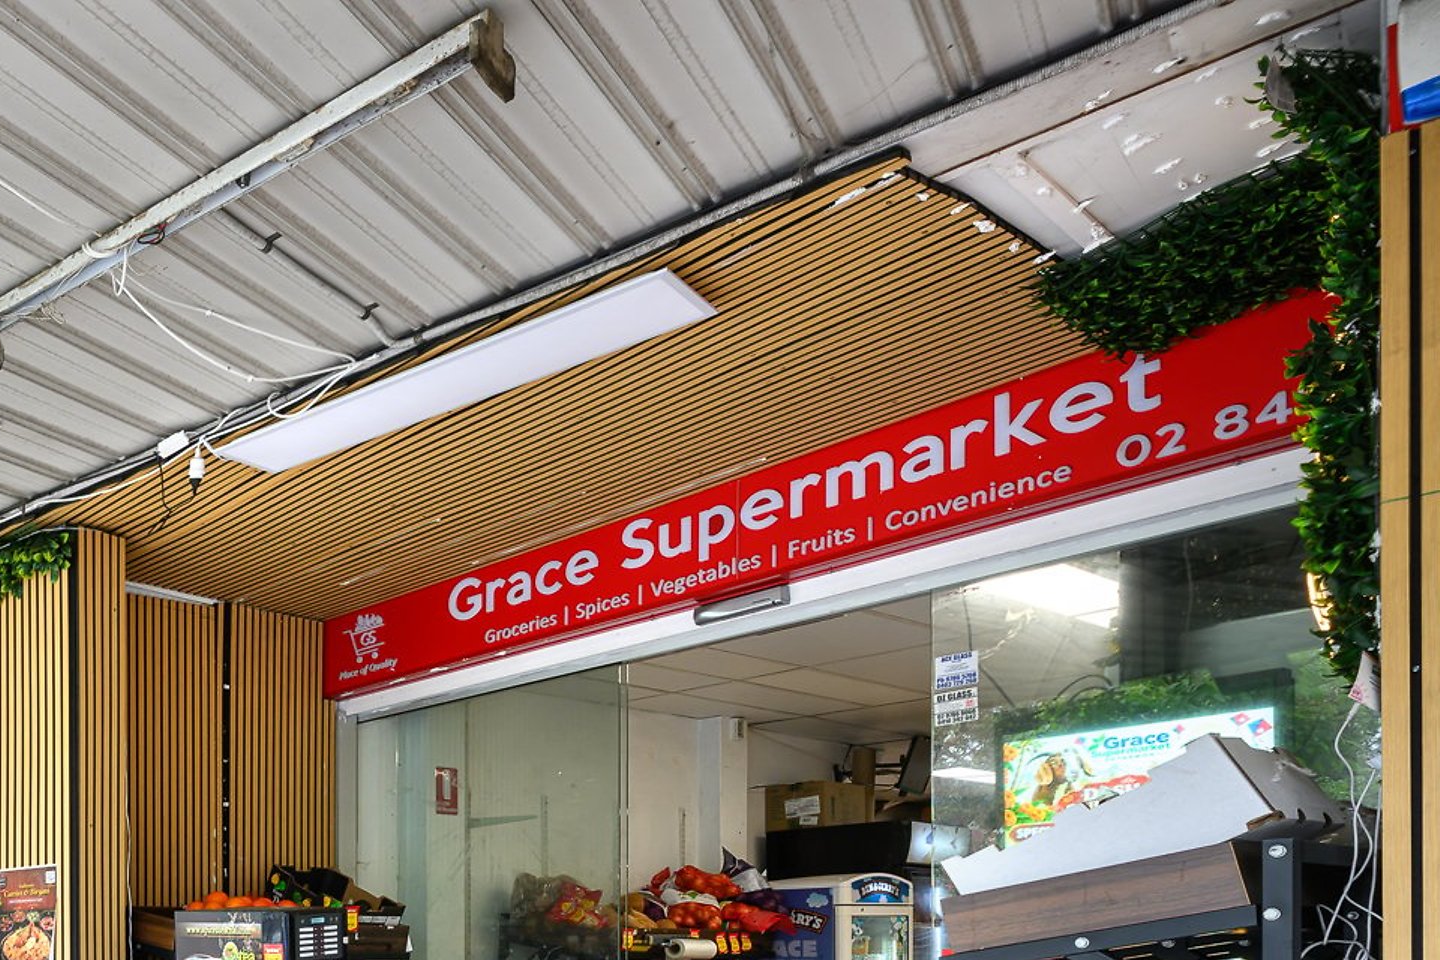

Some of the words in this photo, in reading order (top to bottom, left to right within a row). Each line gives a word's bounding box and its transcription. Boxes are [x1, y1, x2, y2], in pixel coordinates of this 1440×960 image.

[1115, 422, 1187, 468] 02
[1212, 389, 1294, 440] 84
[447, 549, 600, 622] Grace
[620, 353, 1162, 570] Supermarket
[483, 614, 558, 645] Groceries
[575, 591, 631, 621] Spices
[651, 553, 762, 598] Vegetables
[787, 525, 856, 560] Fruits
[885, 464, 1073, 531] Convenience
[1103, 731, 1170, 750] Grace
[773, 939, 819, 958] ACE
